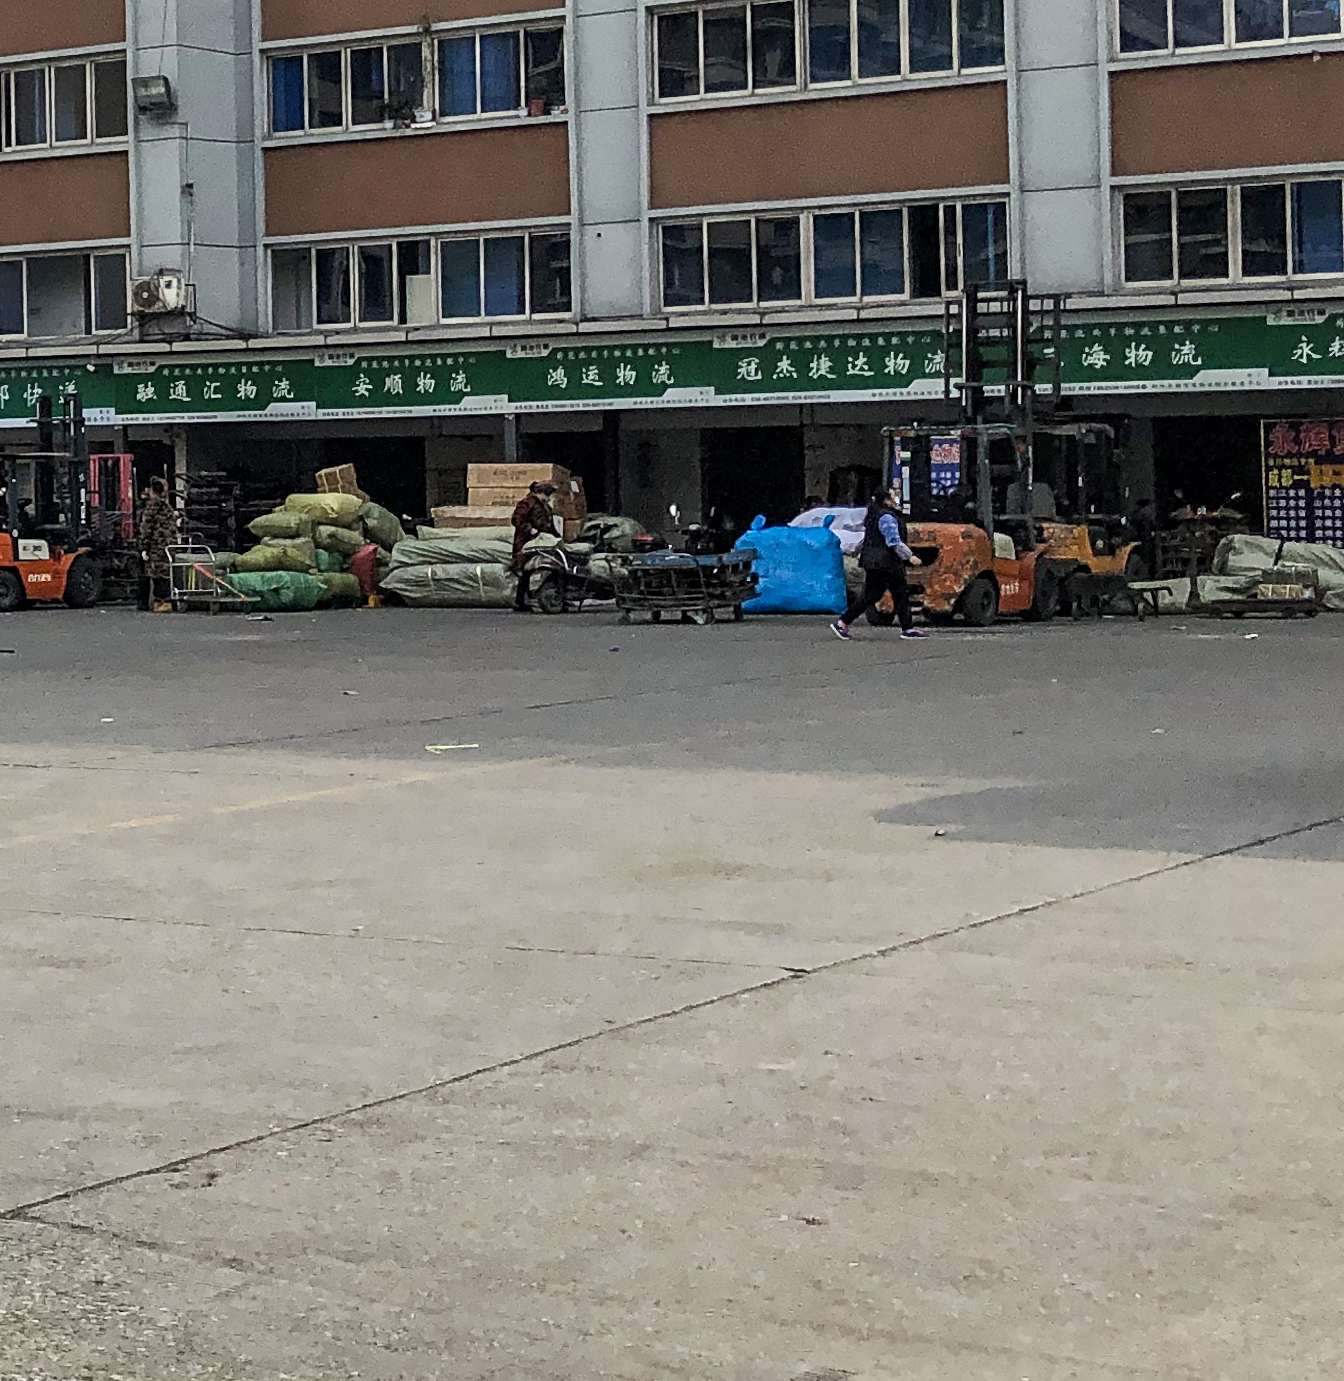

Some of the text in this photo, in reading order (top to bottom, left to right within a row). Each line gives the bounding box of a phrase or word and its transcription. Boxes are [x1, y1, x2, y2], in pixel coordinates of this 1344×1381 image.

[547, 361, 675, 389] 鸿运物流
[736, 349, 951, 381] 冠杰捷达物流
[136, 378, 294, 403] 融通汇物流
[352, 371, 472, 397] 安顺物流
